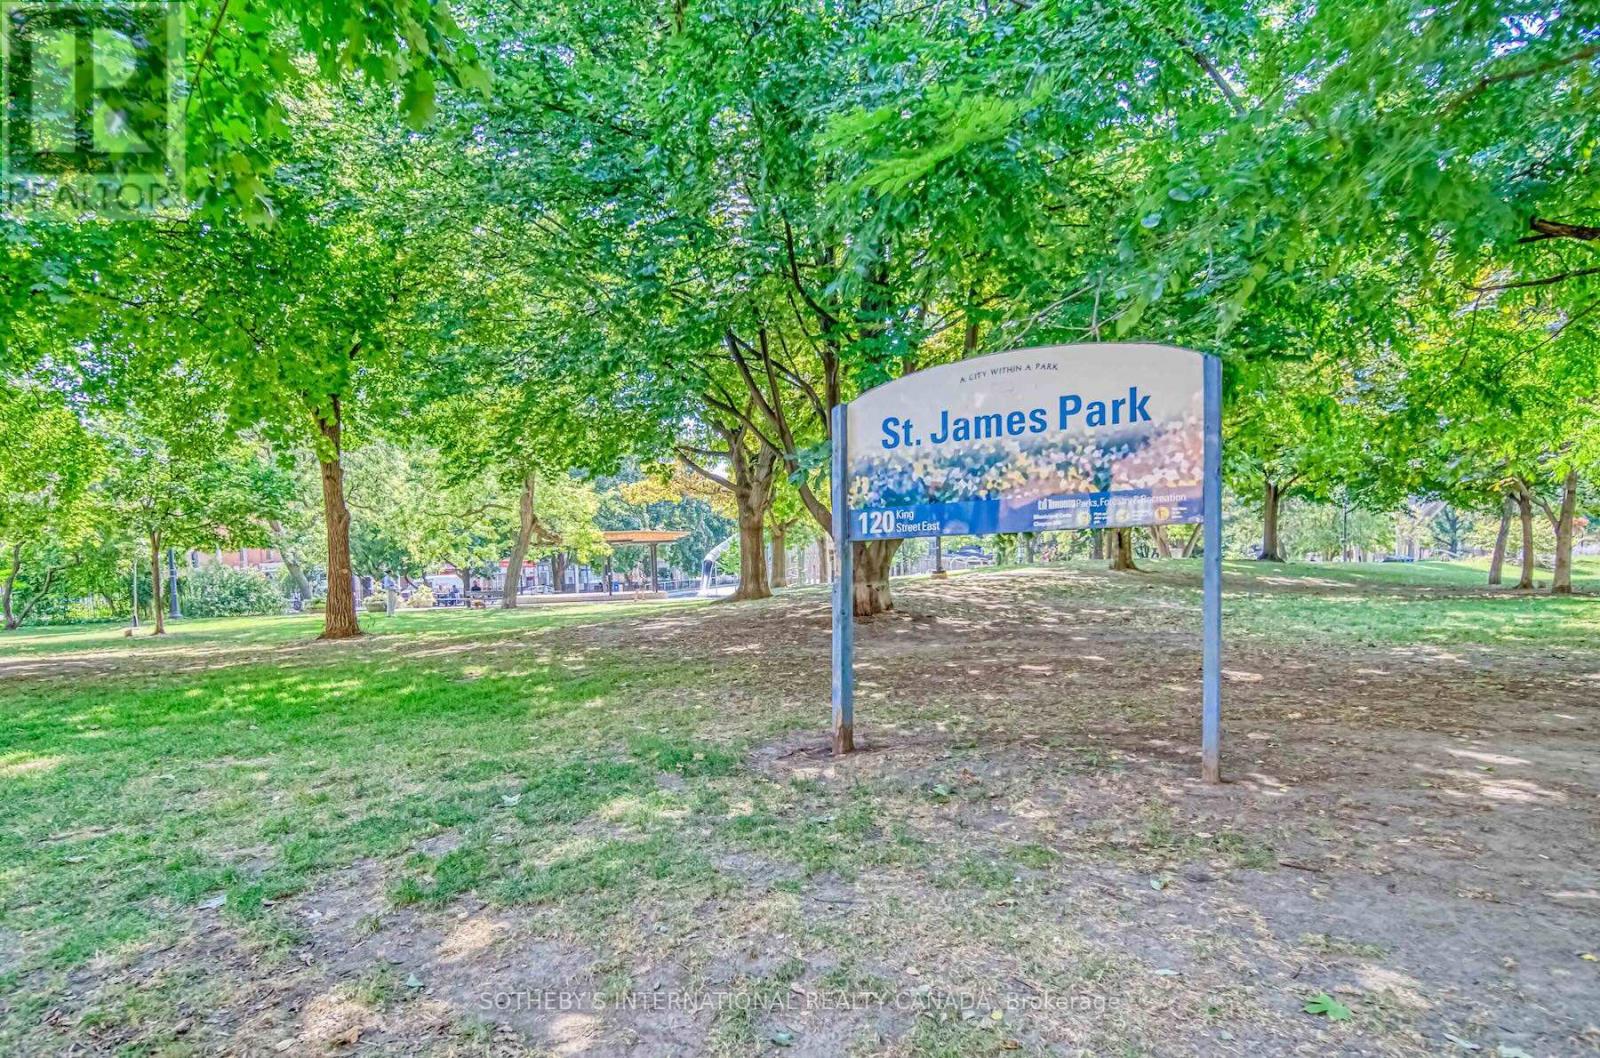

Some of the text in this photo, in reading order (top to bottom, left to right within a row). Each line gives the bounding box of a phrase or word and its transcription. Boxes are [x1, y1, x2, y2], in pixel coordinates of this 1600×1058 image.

[968, 371, 987, 381] CITY
[990, 365, 1022, 376] WITHIN
[1035, 362, 1058, 371] PARK
[881, 386, 1152, 449] St. James Park
[858, 510, 895, 534] 120
[896, 509, 914, 520] King
[896, 520, 940, 533] Street East
